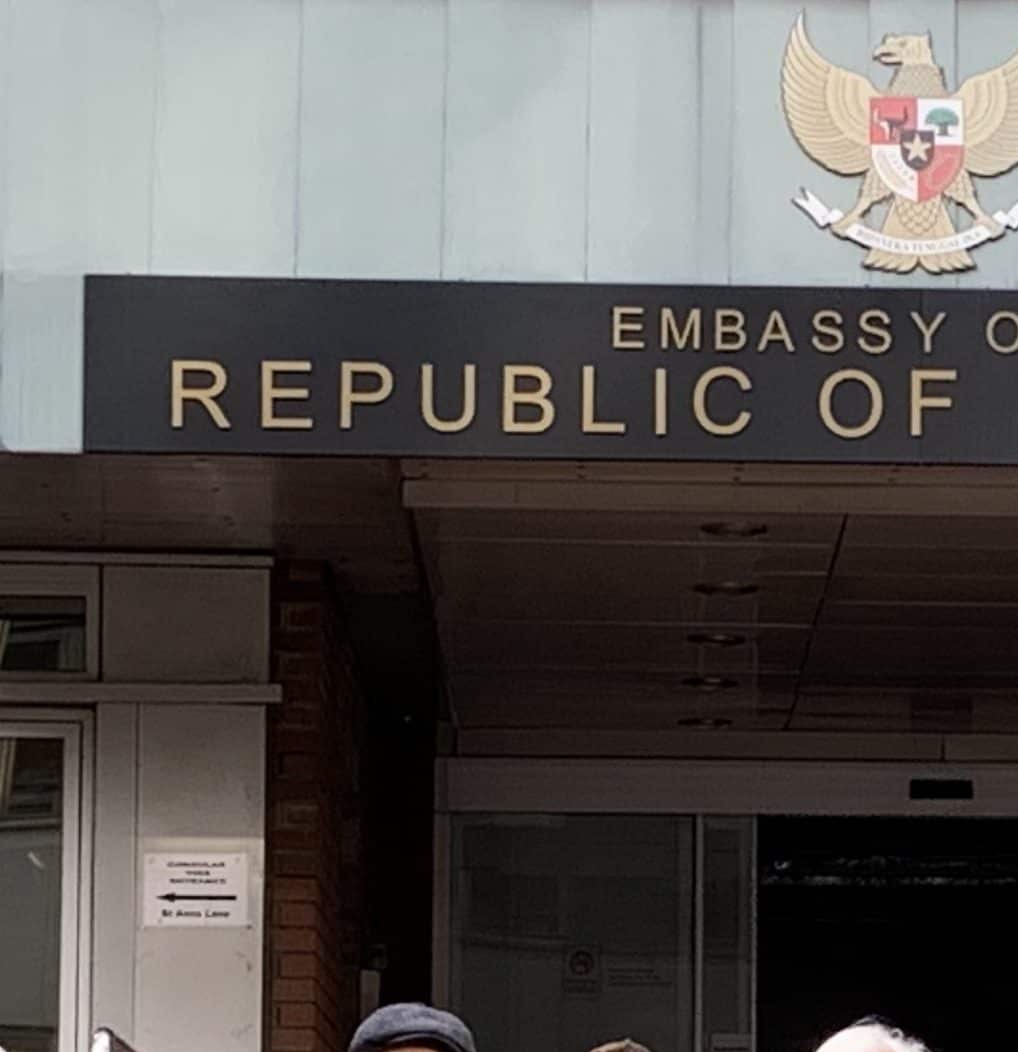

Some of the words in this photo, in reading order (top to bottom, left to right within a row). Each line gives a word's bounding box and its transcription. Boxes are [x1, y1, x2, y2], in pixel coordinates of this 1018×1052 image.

[612, 306, 946, 353] EMBASSY
[170, 360, 752, 437] REPUBLIC
[819, 369, 957, 439] OF
